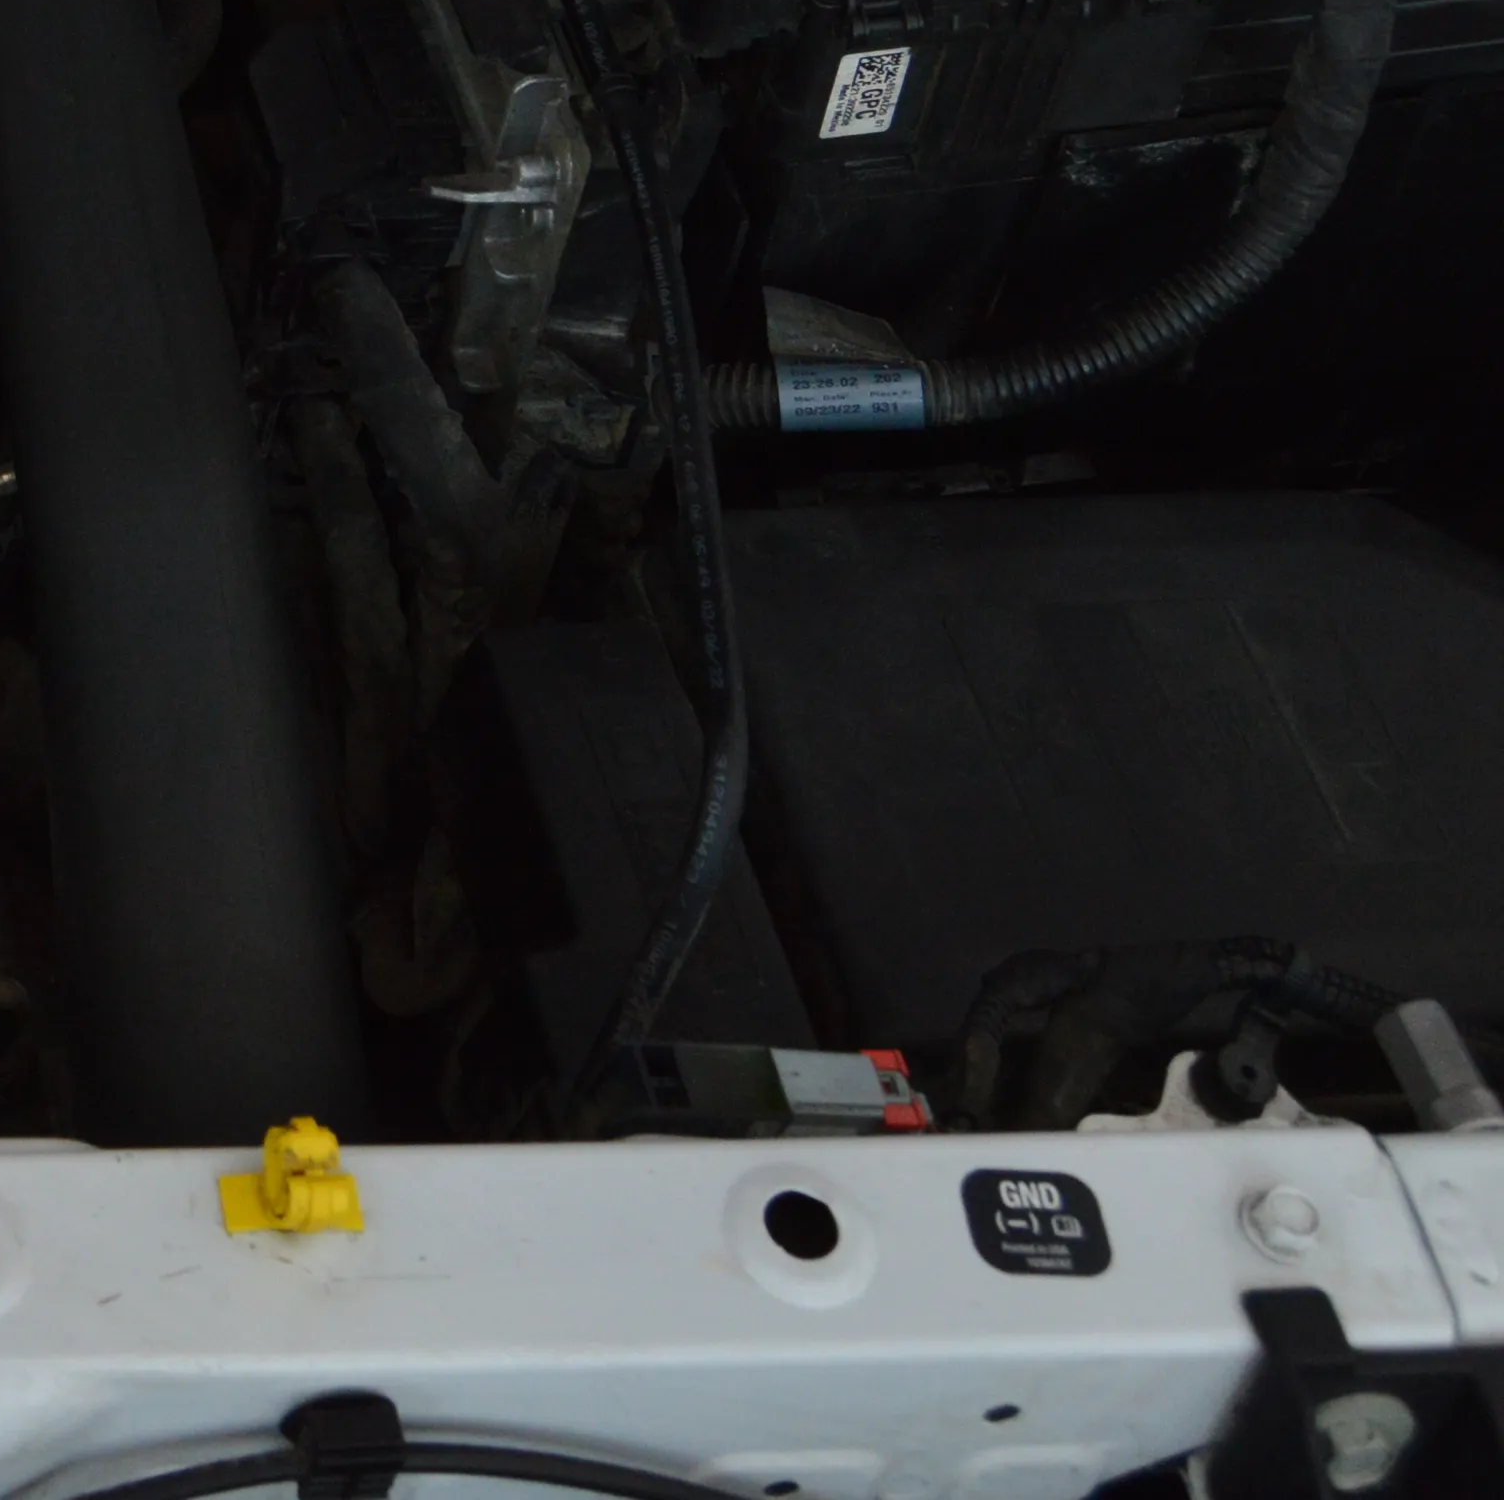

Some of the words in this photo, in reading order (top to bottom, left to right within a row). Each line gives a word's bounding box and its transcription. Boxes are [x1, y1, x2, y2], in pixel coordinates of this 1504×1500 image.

[855, 88, 883, 120] GPC
[873, 373, 902, 383] 202
[871, 402, 900, 414] 931
[998, 1179, 1062, 1210] GND
